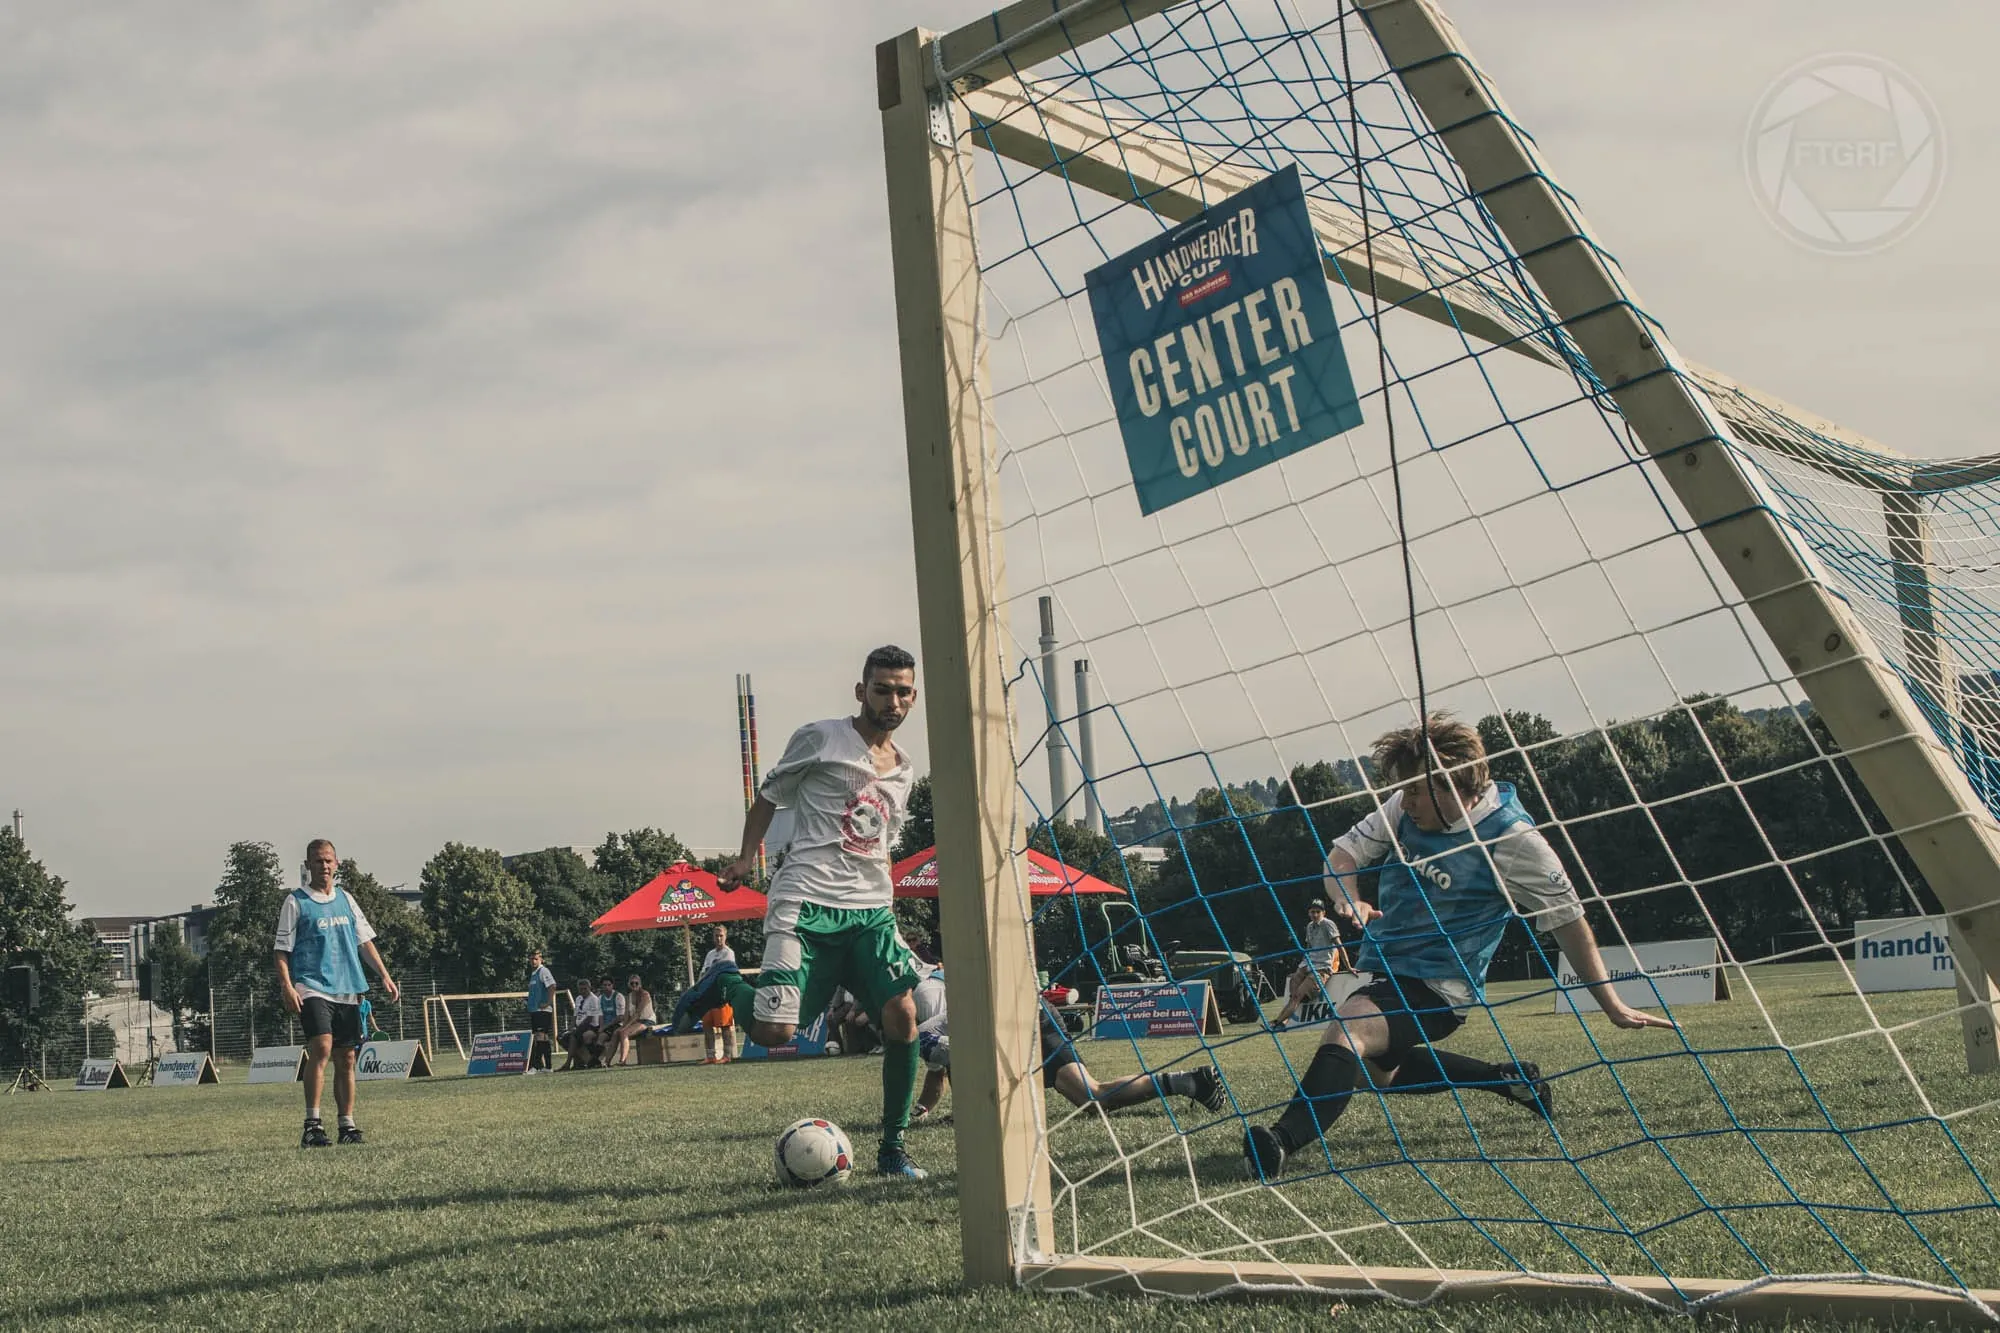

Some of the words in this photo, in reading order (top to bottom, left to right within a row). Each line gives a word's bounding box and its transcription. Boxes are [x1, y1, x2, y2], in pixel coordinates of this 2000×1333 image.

[1131, 207, 1260, 310] HANDWERKER
[1179, 259, 1222, 288] CUP
[1129, 277, 1314, 417] CENTER
[1170, 365, 1301, 478] COURT
[894, 875, 939, 889] Rothau
[1862, 931, 1950, 960] handw
[886, 961, 906, 982] 17
[1101, 990, 1141, 999] Ensatz,
[1152, 1009, 1170, 1018] bei
[158, 1059, 198, 1073] handwerk
